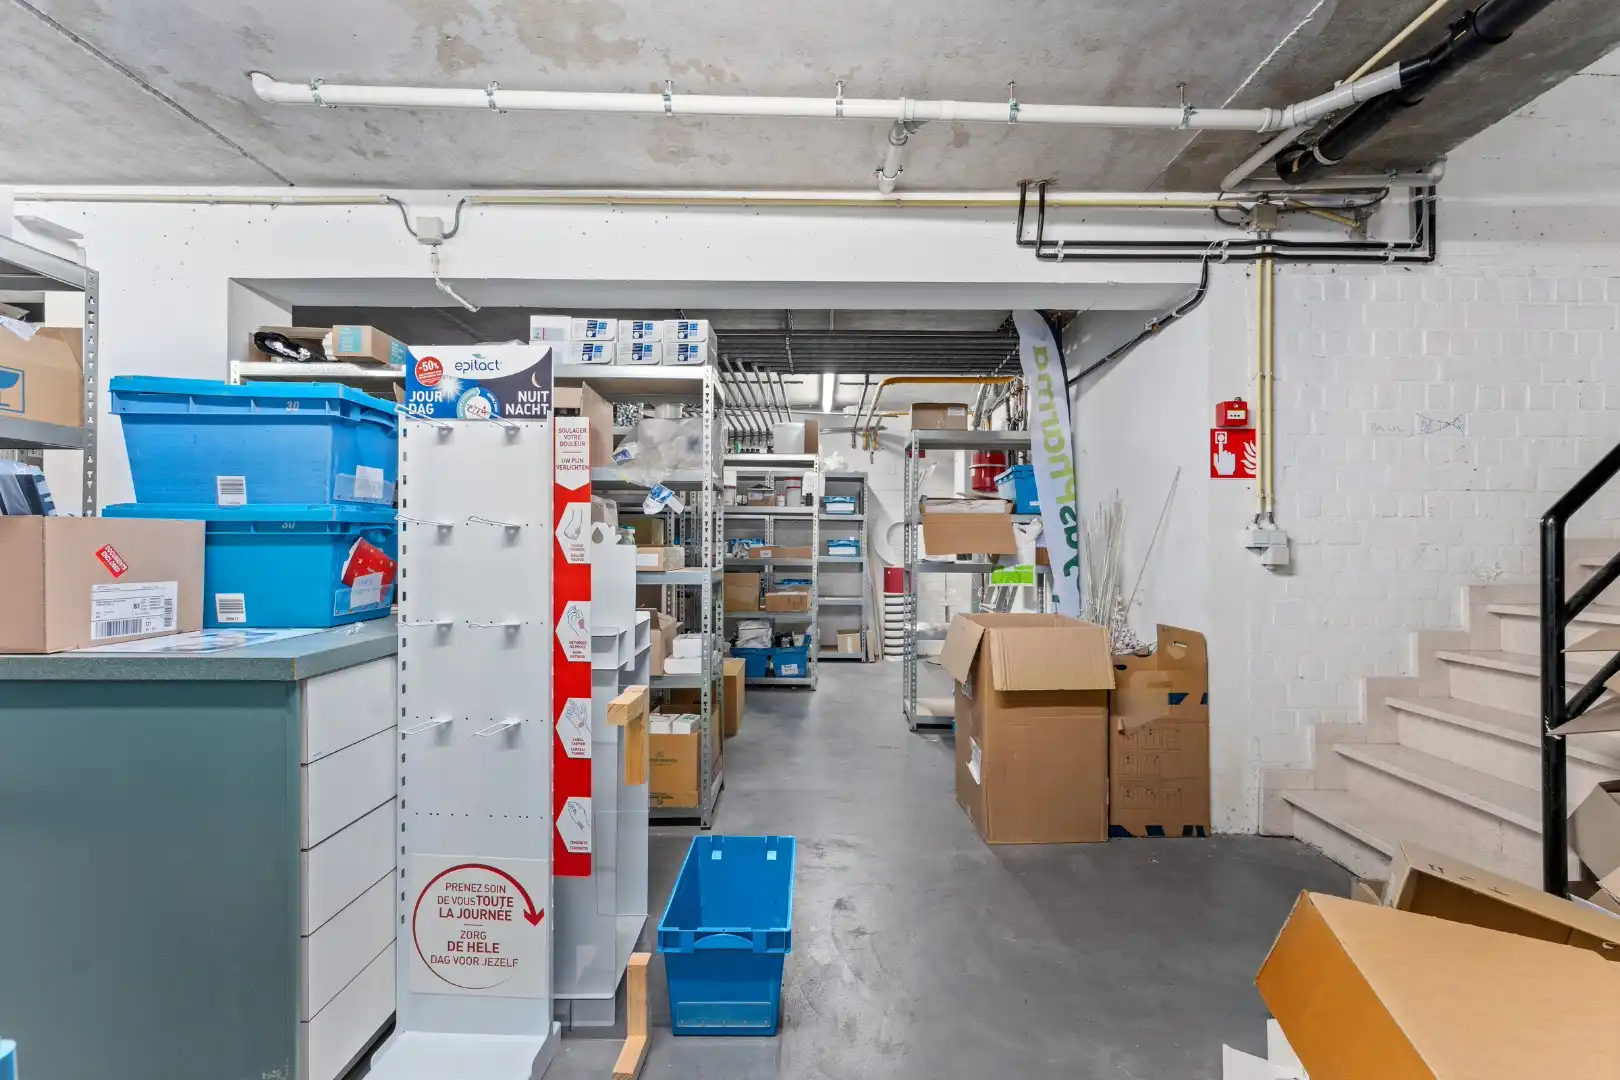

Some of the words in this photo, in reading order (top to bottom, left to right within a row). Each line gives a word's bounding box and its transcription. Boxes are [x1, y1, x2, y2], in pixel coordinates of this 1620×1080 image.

[418, 360, 441, 372] -50%
[454, 359, 500, 374] epitact
[409, 390, 443, 403] JOUR
[518, 390, 550, 403] NUIT
[408, 403, 435, 415] DAG
[505, 403, 549, 415] NACHT
[445, 882, 482, 893] PRENEZ
[484, 884, 506, 894] SOIN
[437, 895, 450, 905] DE
[451, 896, 476, 906] VOUS
[476, 895, 514, 908] TOUTE
[439, 907, 454, 919] LA
[456, 907, 512, 921] JOURNÉE
[460, 930, 487, 940] ZORG
[447, 940, 463, 952] DE
[467, 941, 500, 954] HELE
[430, 954, 451, 965] DAG
[453, 956, 480, 966] VOOR
[481, 957, 519, 968] JEZELF
